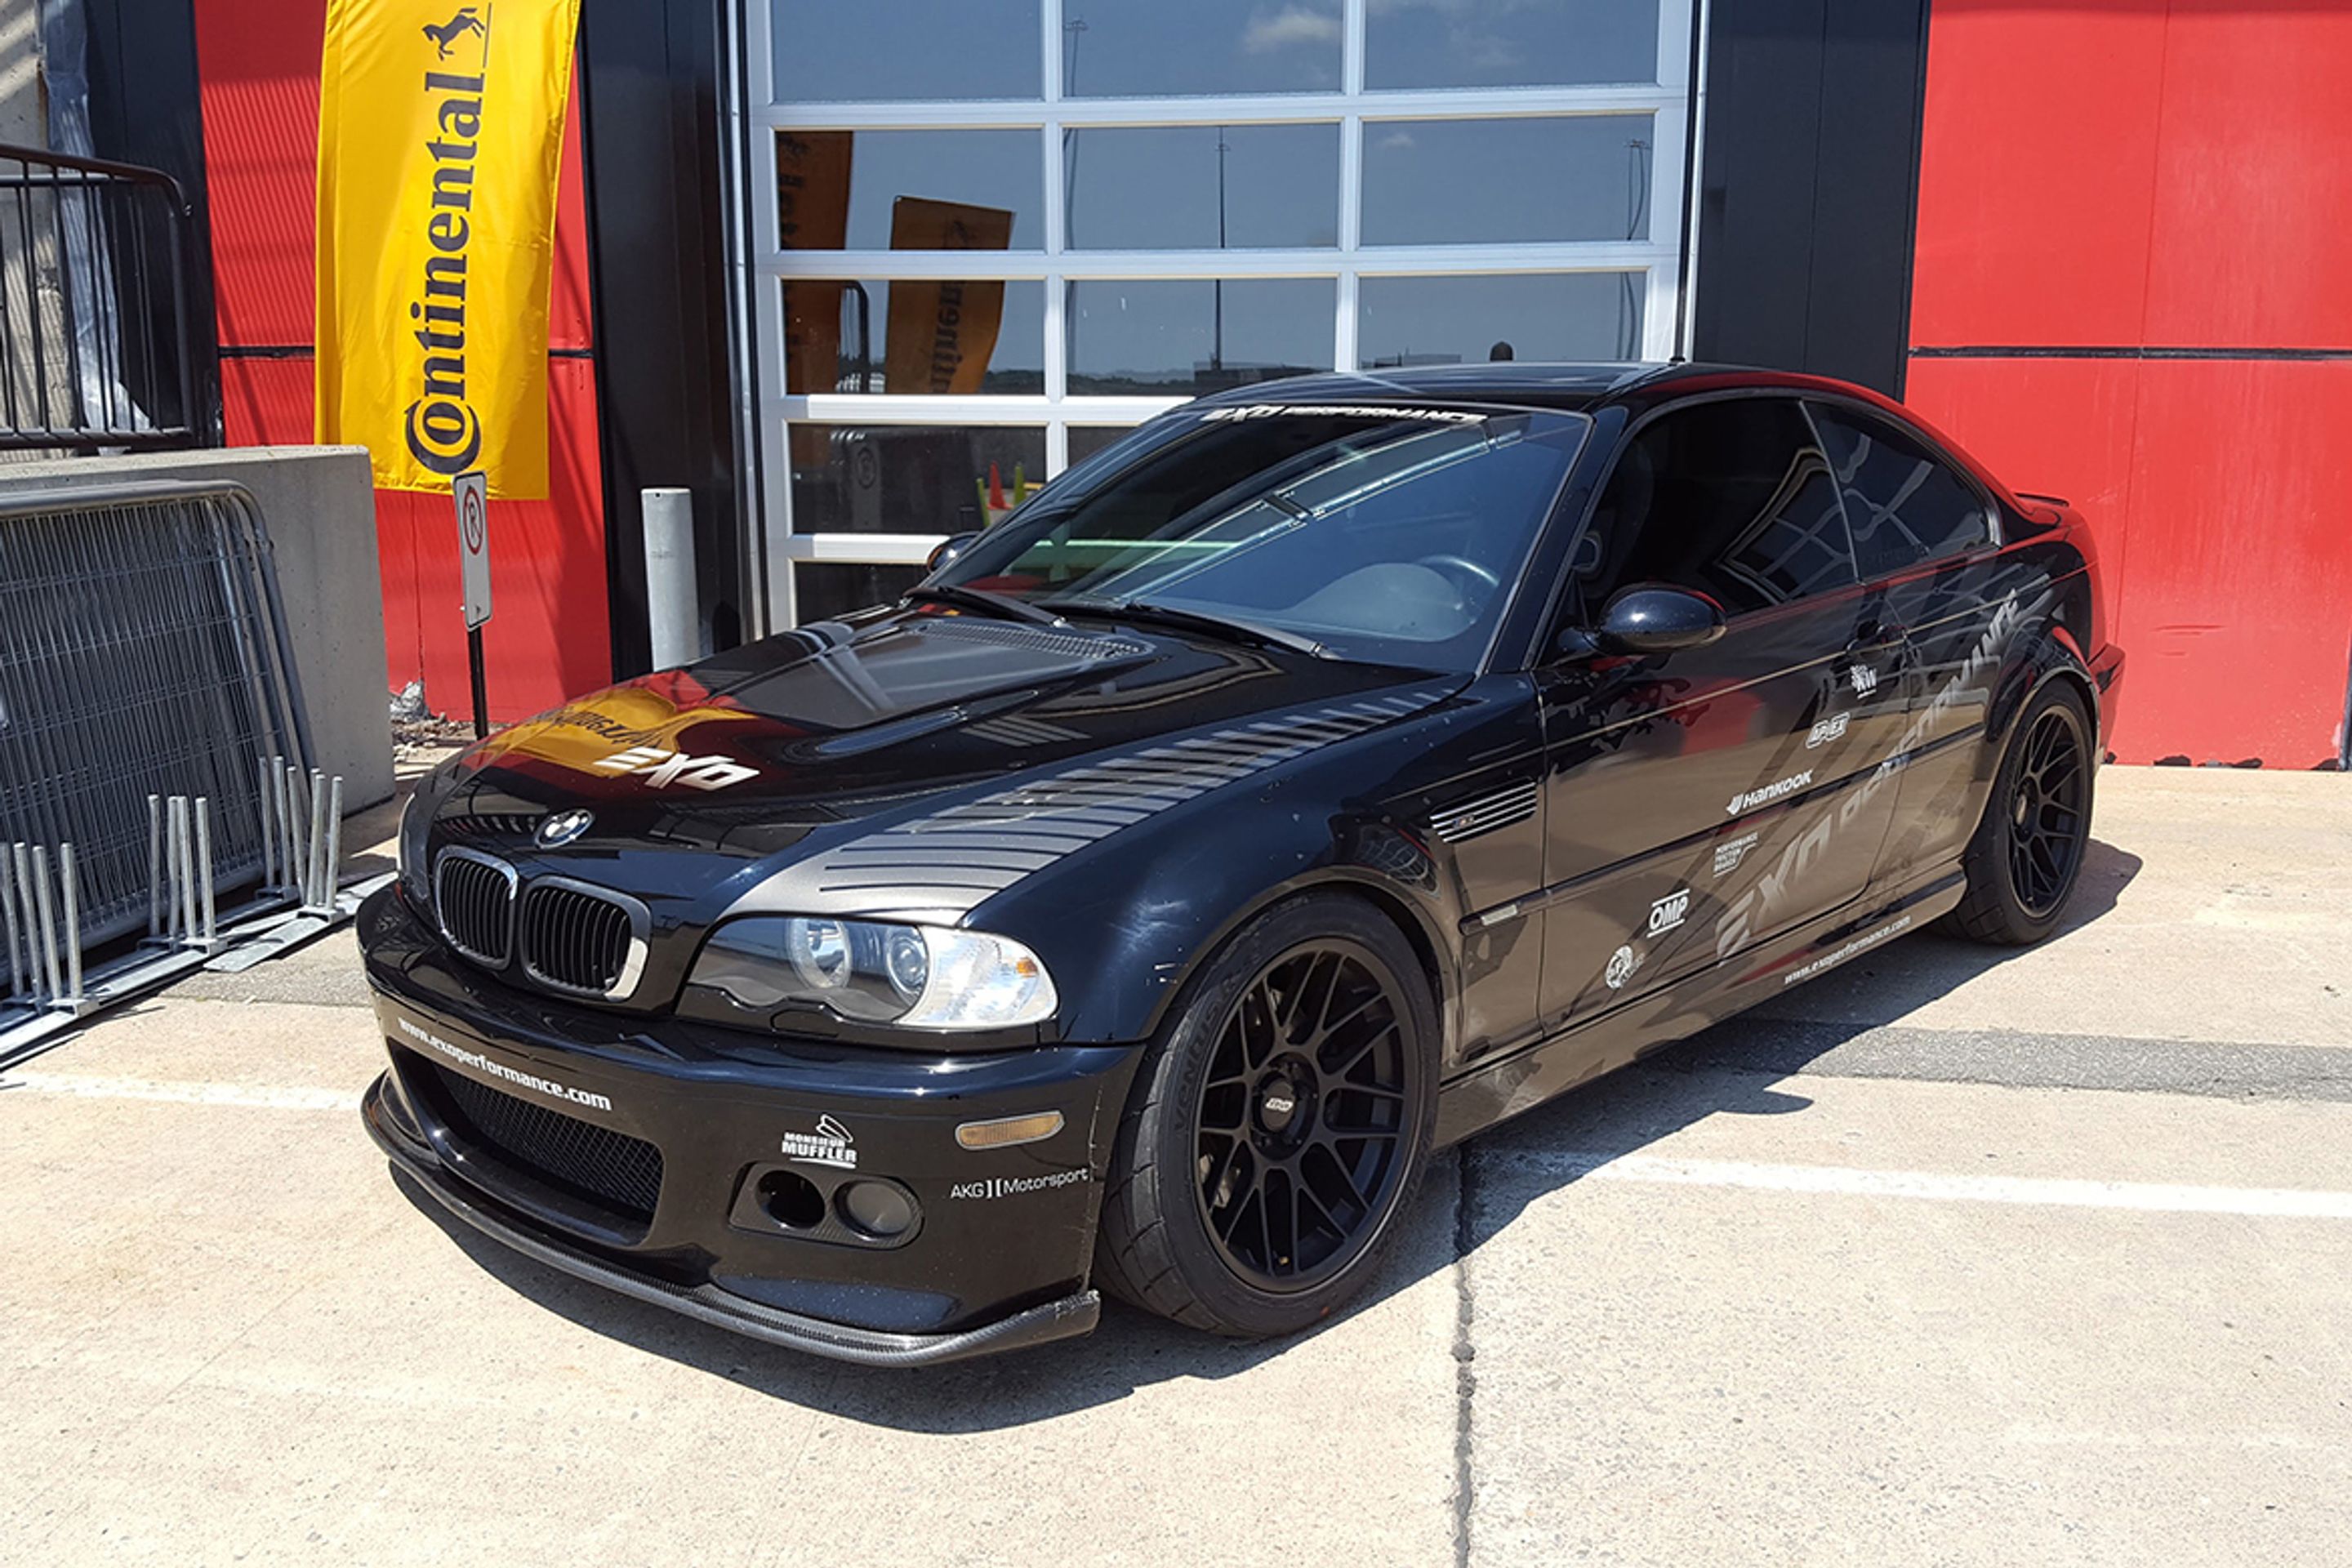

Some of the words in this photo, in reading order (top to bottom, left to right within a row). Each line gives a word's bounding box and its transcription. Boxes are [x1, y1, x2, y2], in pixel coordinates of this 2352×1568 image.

[404, 72, 484, 474] Continental
[593, 746, 761, 791] EXO
[1650, 896, 1688, 930] OMP
[398, 1017, 612, 1111] www.exoperformance.com
[782, 1140, 857, 1163] MUFFLER
